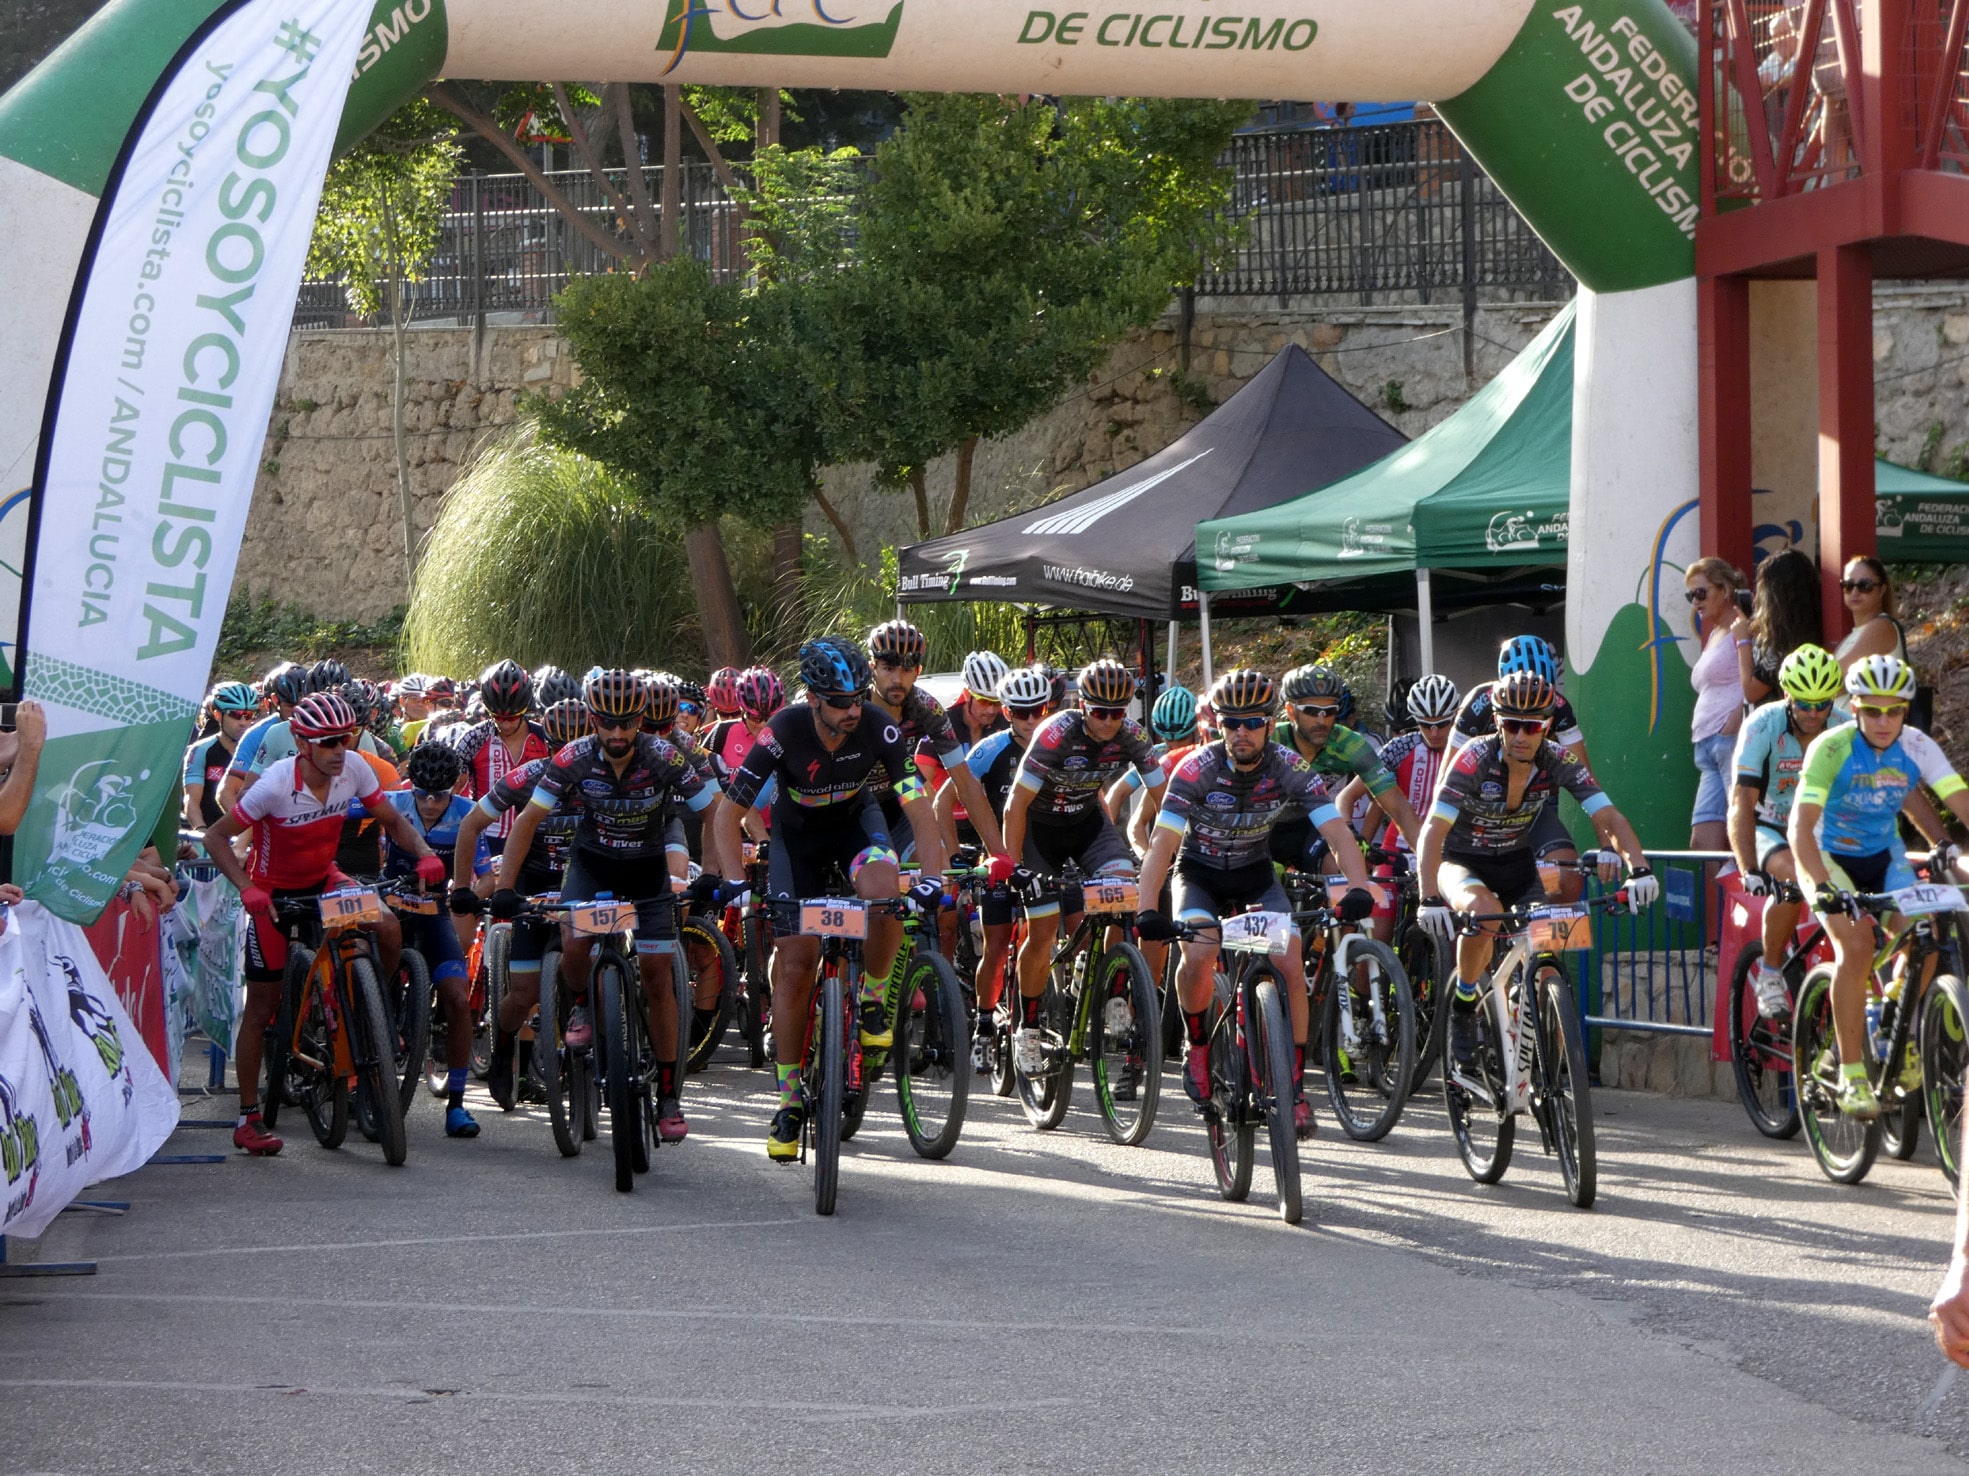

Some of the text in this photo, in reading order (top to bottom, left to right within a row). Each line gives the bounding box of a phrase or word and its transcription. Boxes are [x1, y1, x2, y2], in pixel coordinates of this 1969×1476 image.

[1017, 10, 1319, 52] DE CICLISMO
[1552, 4, 1695, 172] ANDALUZA
[1563, 72, 1615, 124] DE
[121, 59, 234, 371] yosoyciclista.com
[136, 17, 323, 662] #YOSOYCICLISTA
[77, 395, 141, 629] ANDALUCIA
[1903, 512, 1960, 525] ANDALUZA
[901, 571, 950, 591] Bull Timing
[336, 897, 363, 915] 101
[1097, 887, 1125, 904] 165
[590, 907, 618, 927] 157
[821, 910, 845, 927] 38
[1244, 915, 1268, 937] 432
[1548, 921, 1569, 940] 79
